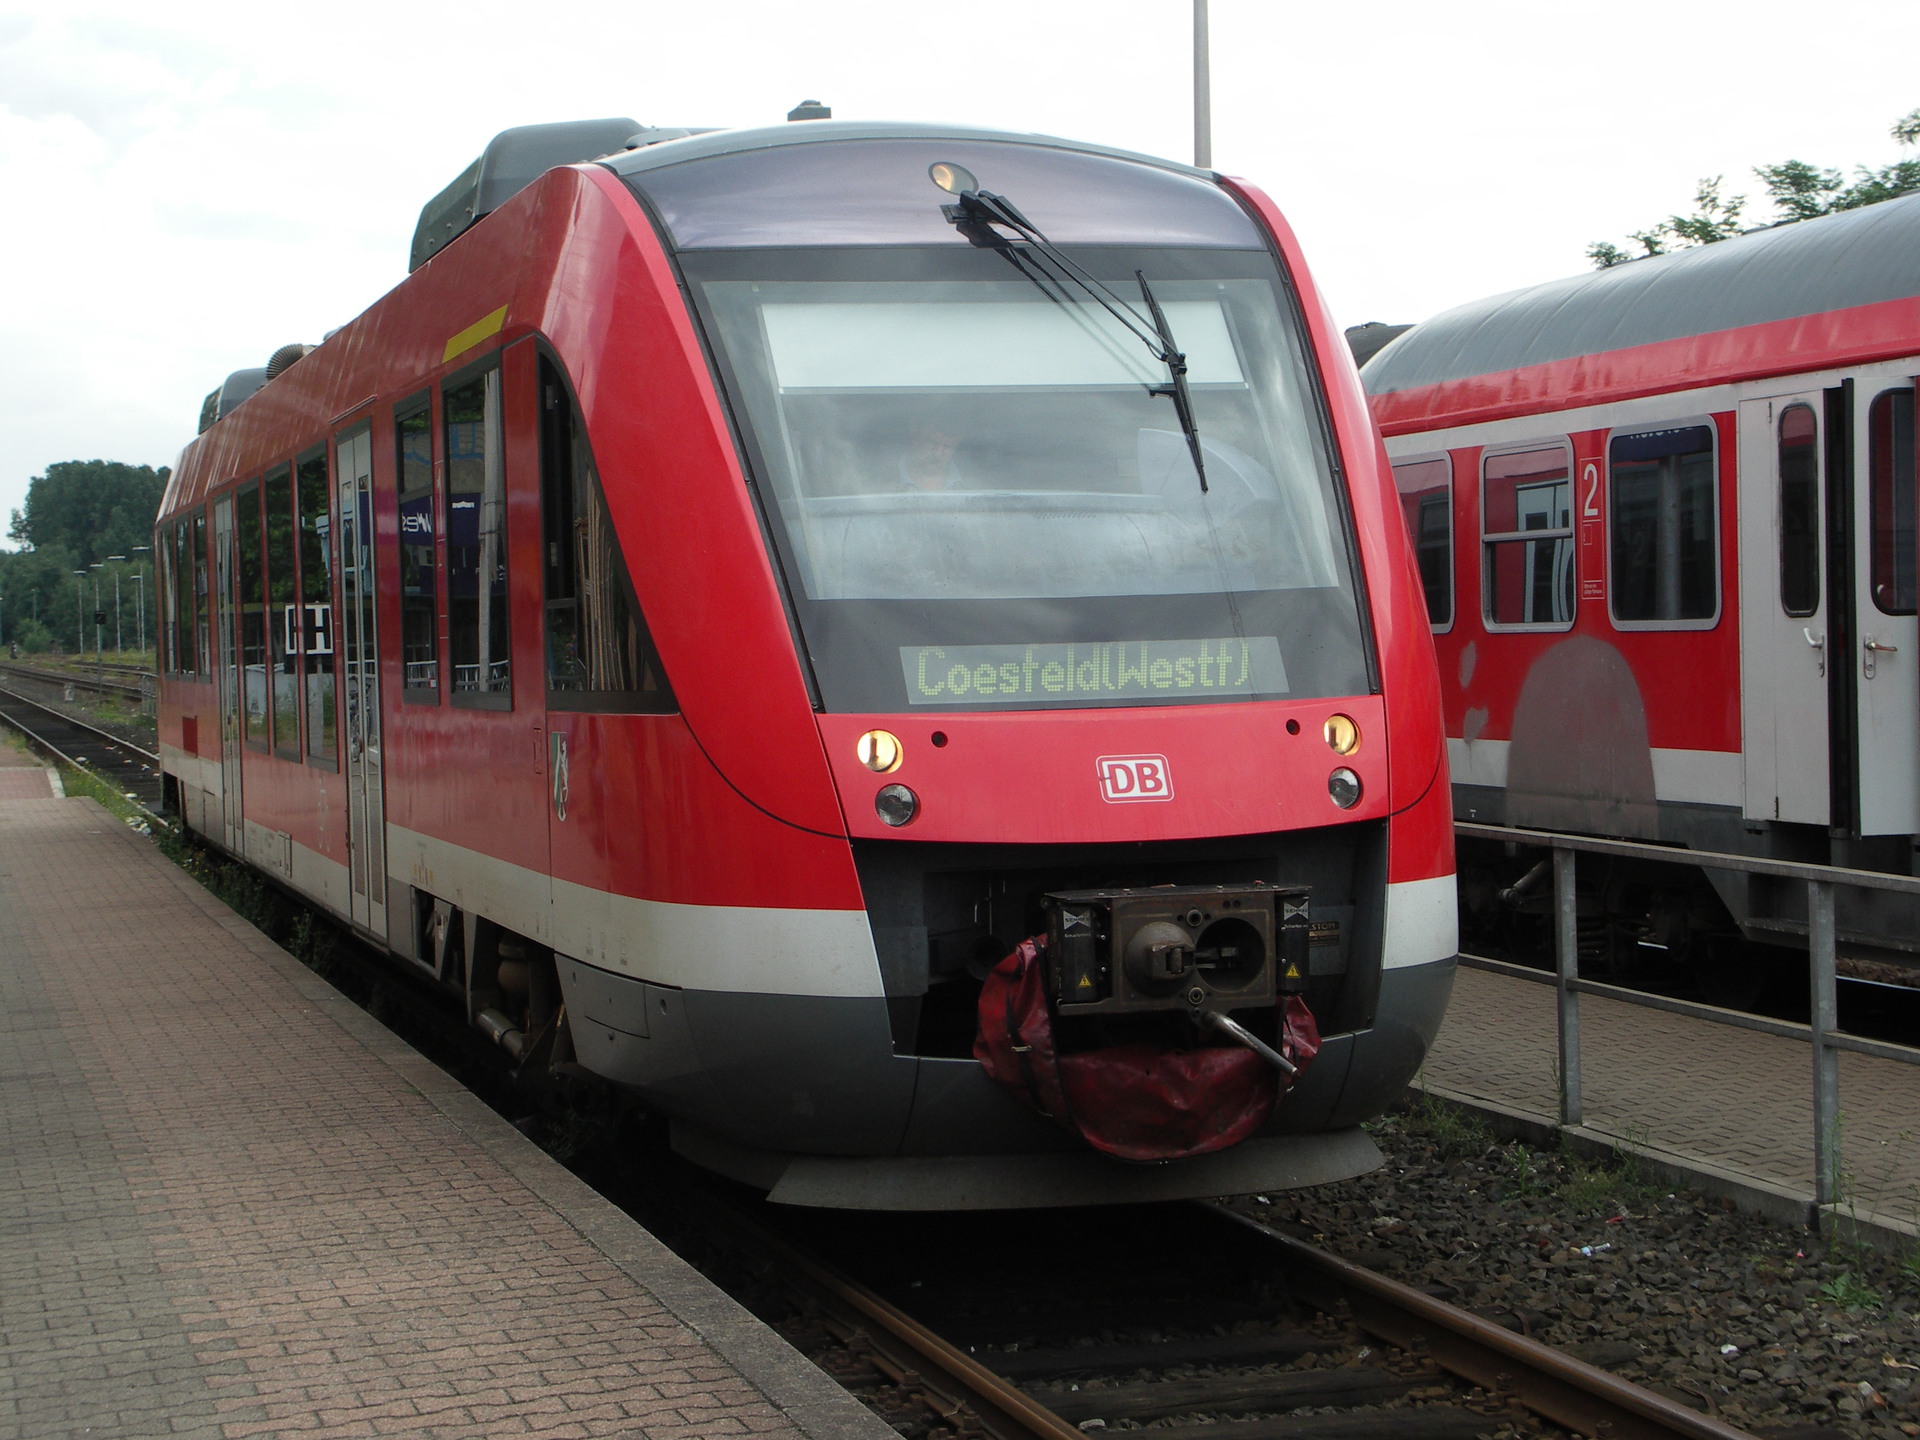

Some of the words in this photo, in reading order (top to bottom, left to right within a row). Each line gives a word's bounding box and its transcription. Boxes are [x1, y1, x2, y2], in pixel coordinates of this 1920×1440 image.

[1583, 463, 1598, 517] 2
[1107, 762, 1163, 794] DB
[1309, 921, 1336, 931] STOM
